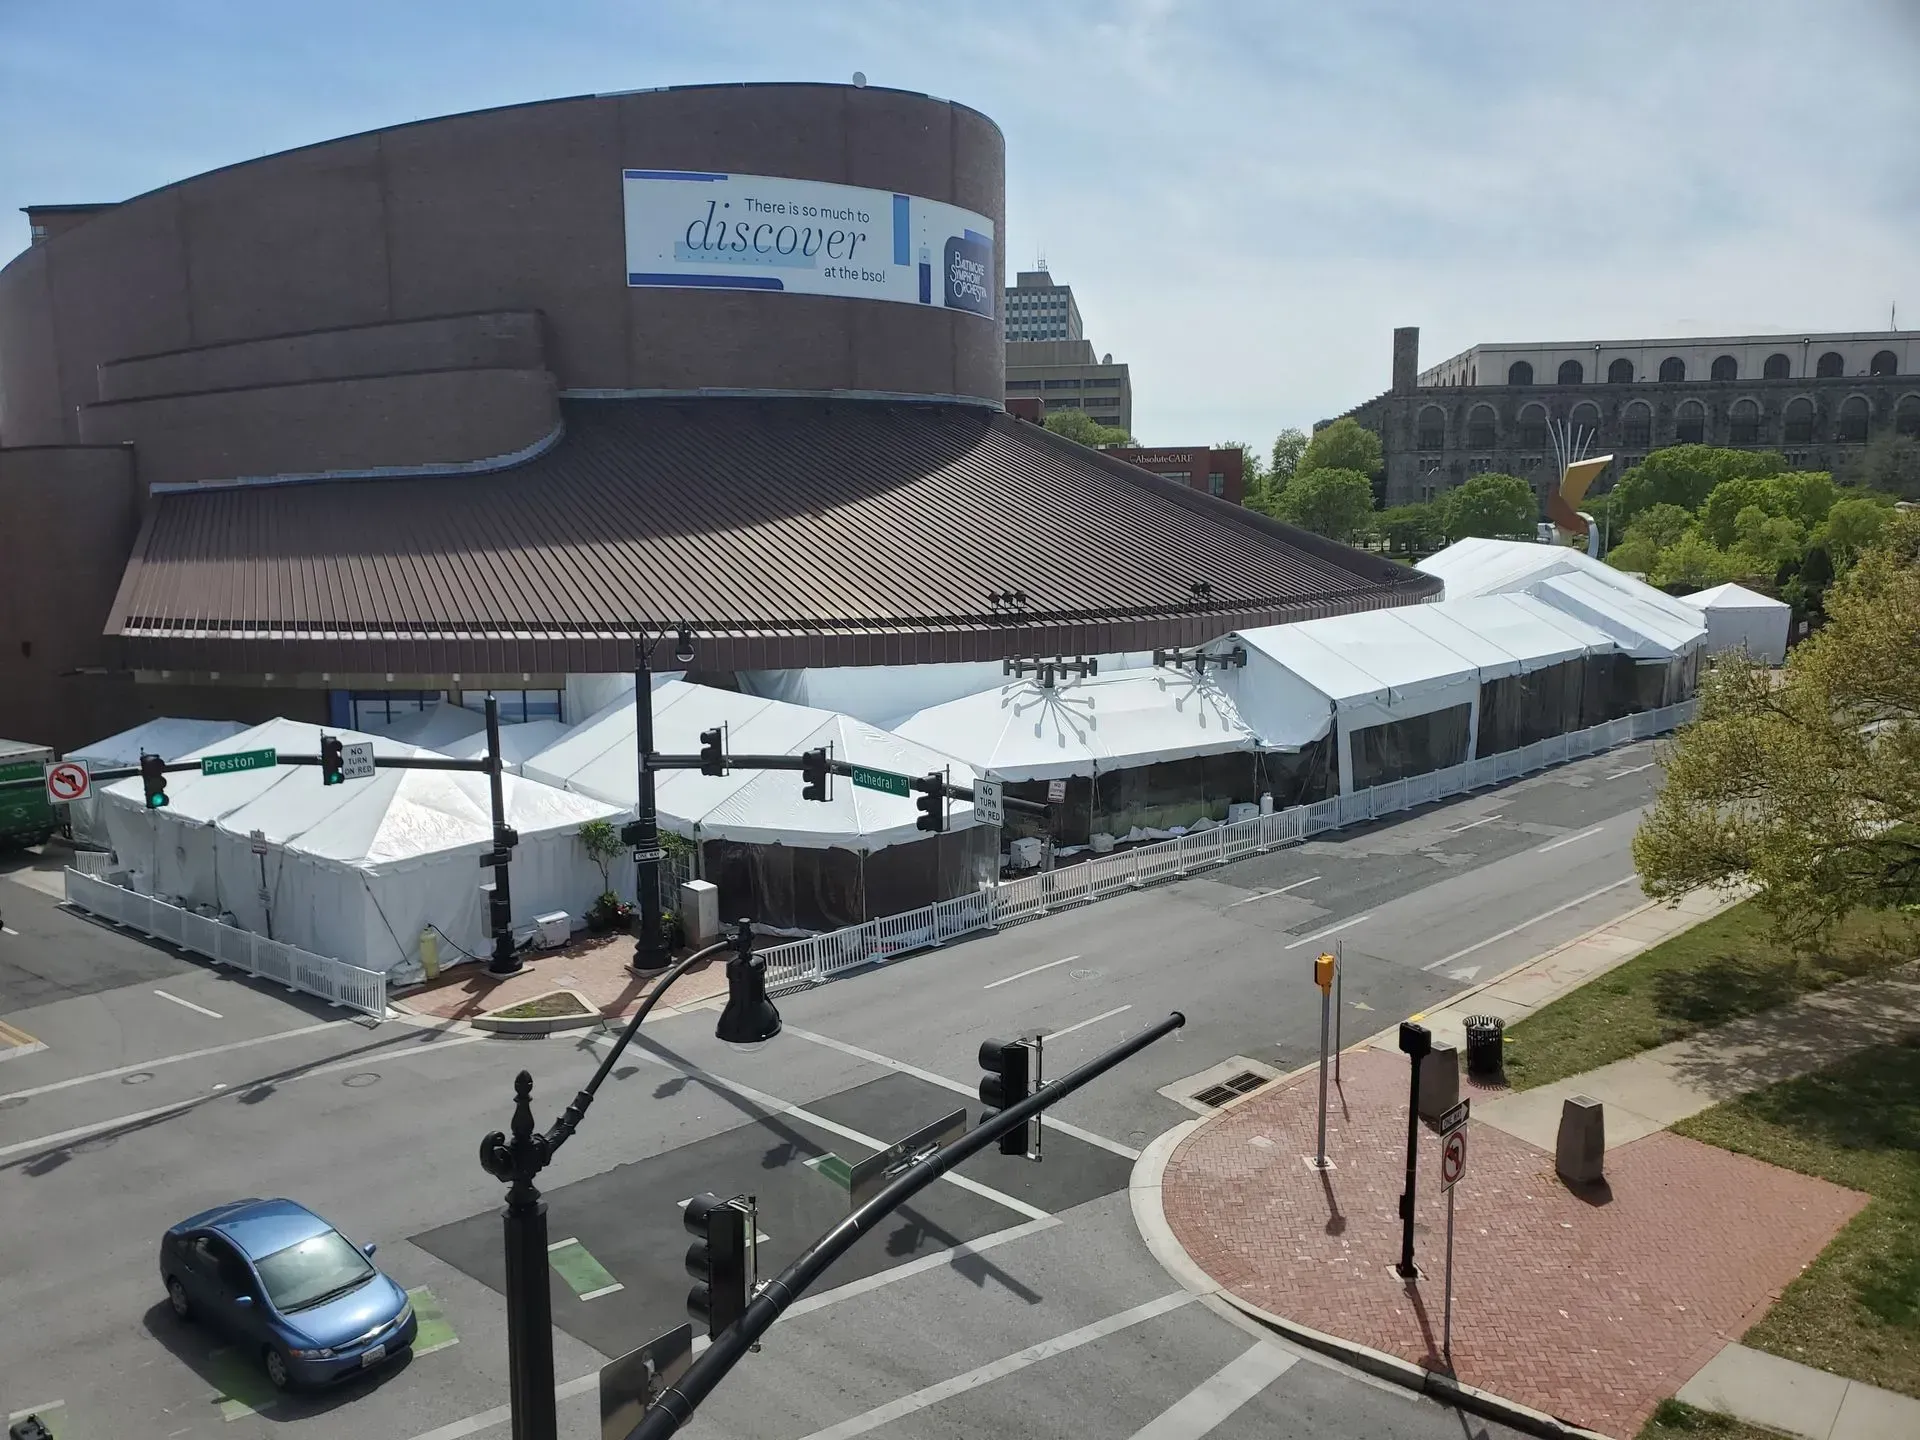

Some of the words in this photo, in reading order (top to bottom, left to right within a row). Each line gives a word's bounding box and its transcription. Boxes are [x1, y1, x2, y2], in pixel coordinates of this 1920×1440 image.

[744, 198, 786, 215] There
[789, 202, 799, 215] is
[802, 206, 819, 217] so
[821, 208, 854, 221] much
[857, 211, 870, 223] to
[685, 200, 866, 260] discover
[824, 267, 836, 278] at
[839, 266, 859, 280] the
[861, 267, 885, 283] bso!
[350, 747, 363, 756] NO
[204, 756, 255, 772] Preston
[348, 756, 368, 765] TURN
[344, 766, 355, 776] ON
[357, 765, 372, 774] RED
[853, 770, 893, 790] Cathedral
[900, 779, 907, 787] ST
[982, 784, 993, 796] NO
[979, 797, 997, 809] TURN
[976, 807, 986, 818] ON
[988, 809, 1001, 821] RED
